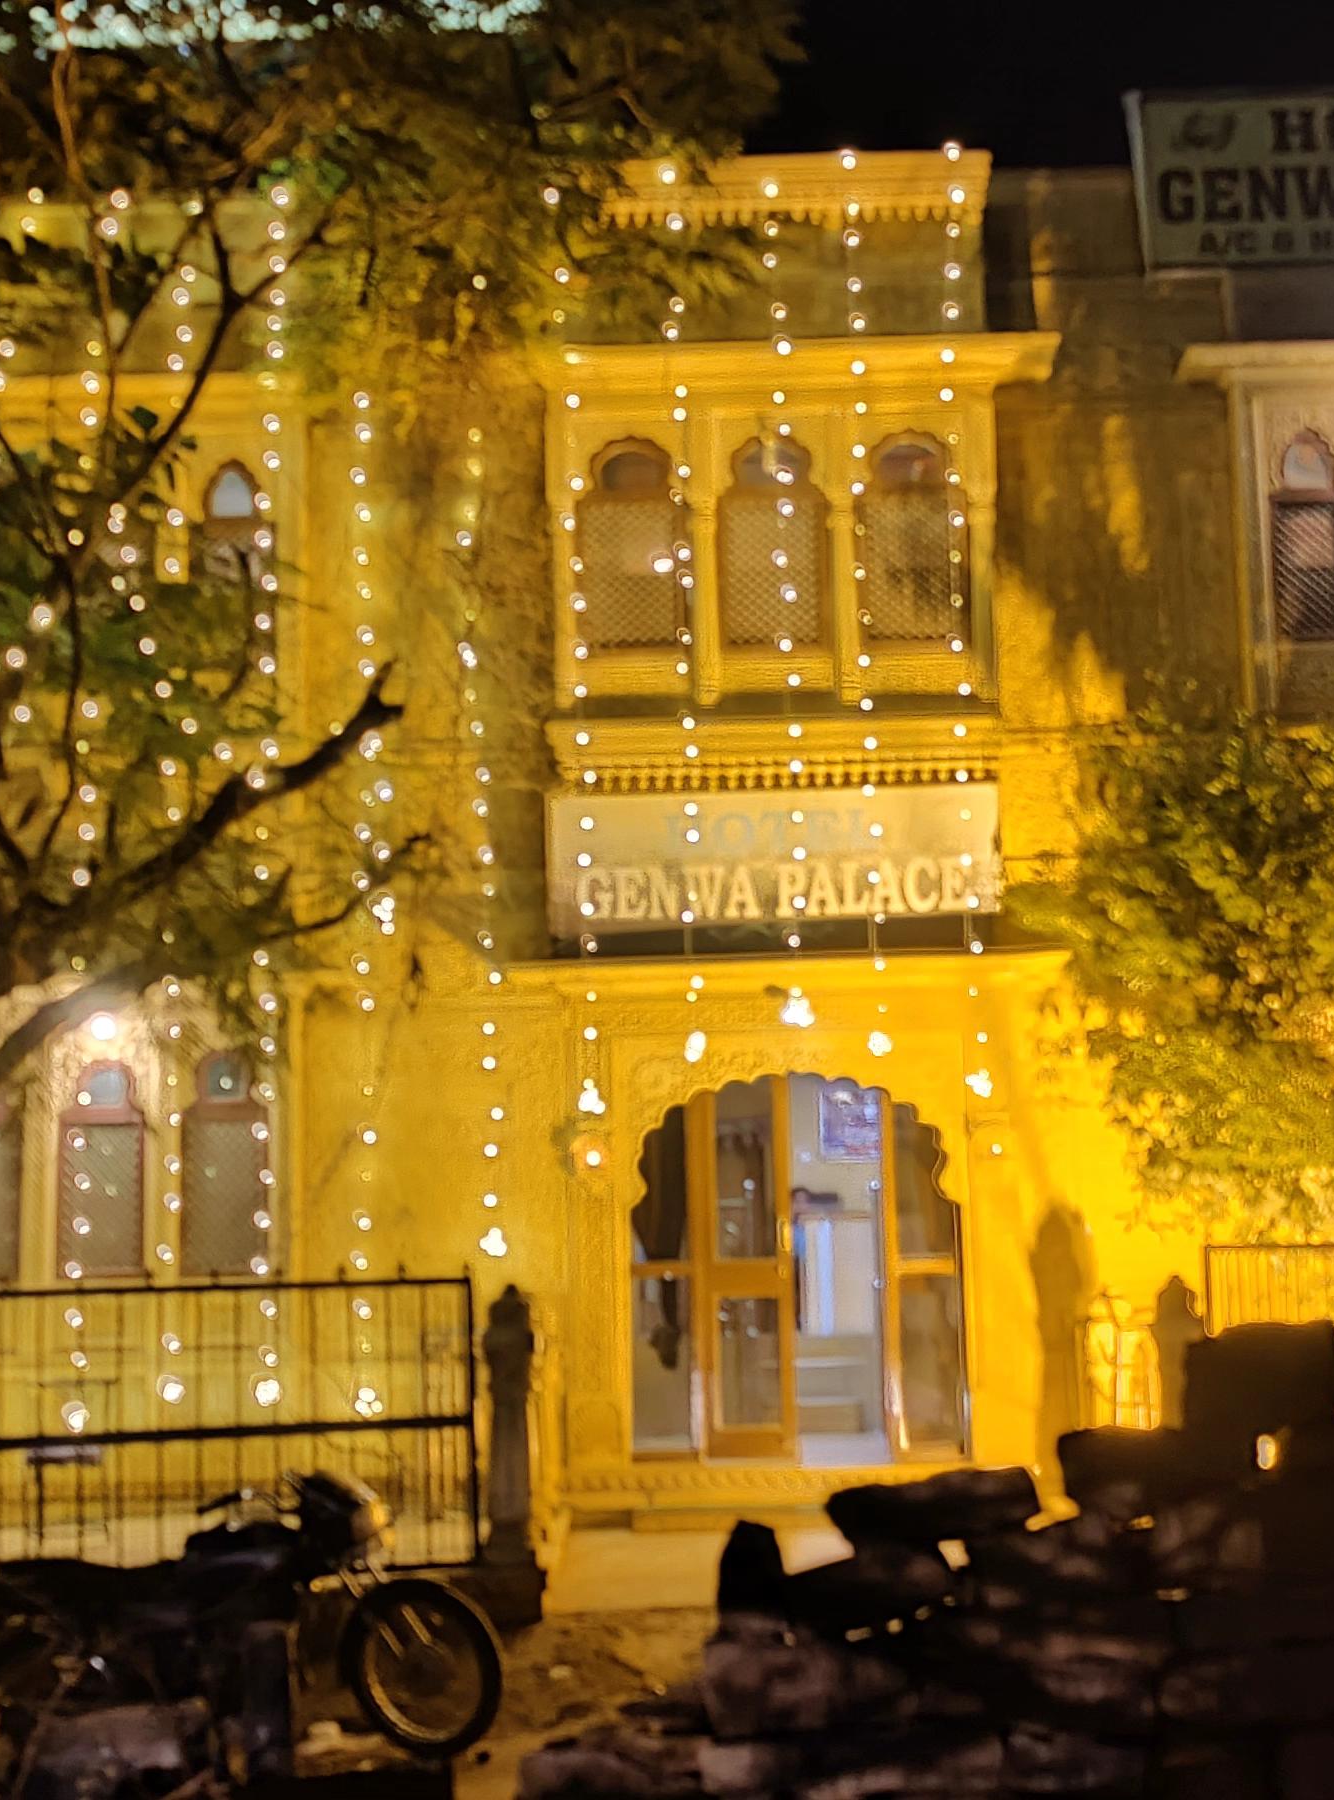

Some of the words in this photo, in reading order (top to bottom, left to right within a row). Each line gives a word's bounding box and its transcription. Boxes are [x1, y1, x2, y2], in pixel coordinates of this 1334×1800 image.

[1198, 226, 1257, 257] A/C
[664, 808, 879, 854] HOTEL
[575, 862, 763, 920] GENWA
[774, 856, 970, 918] PALACE
